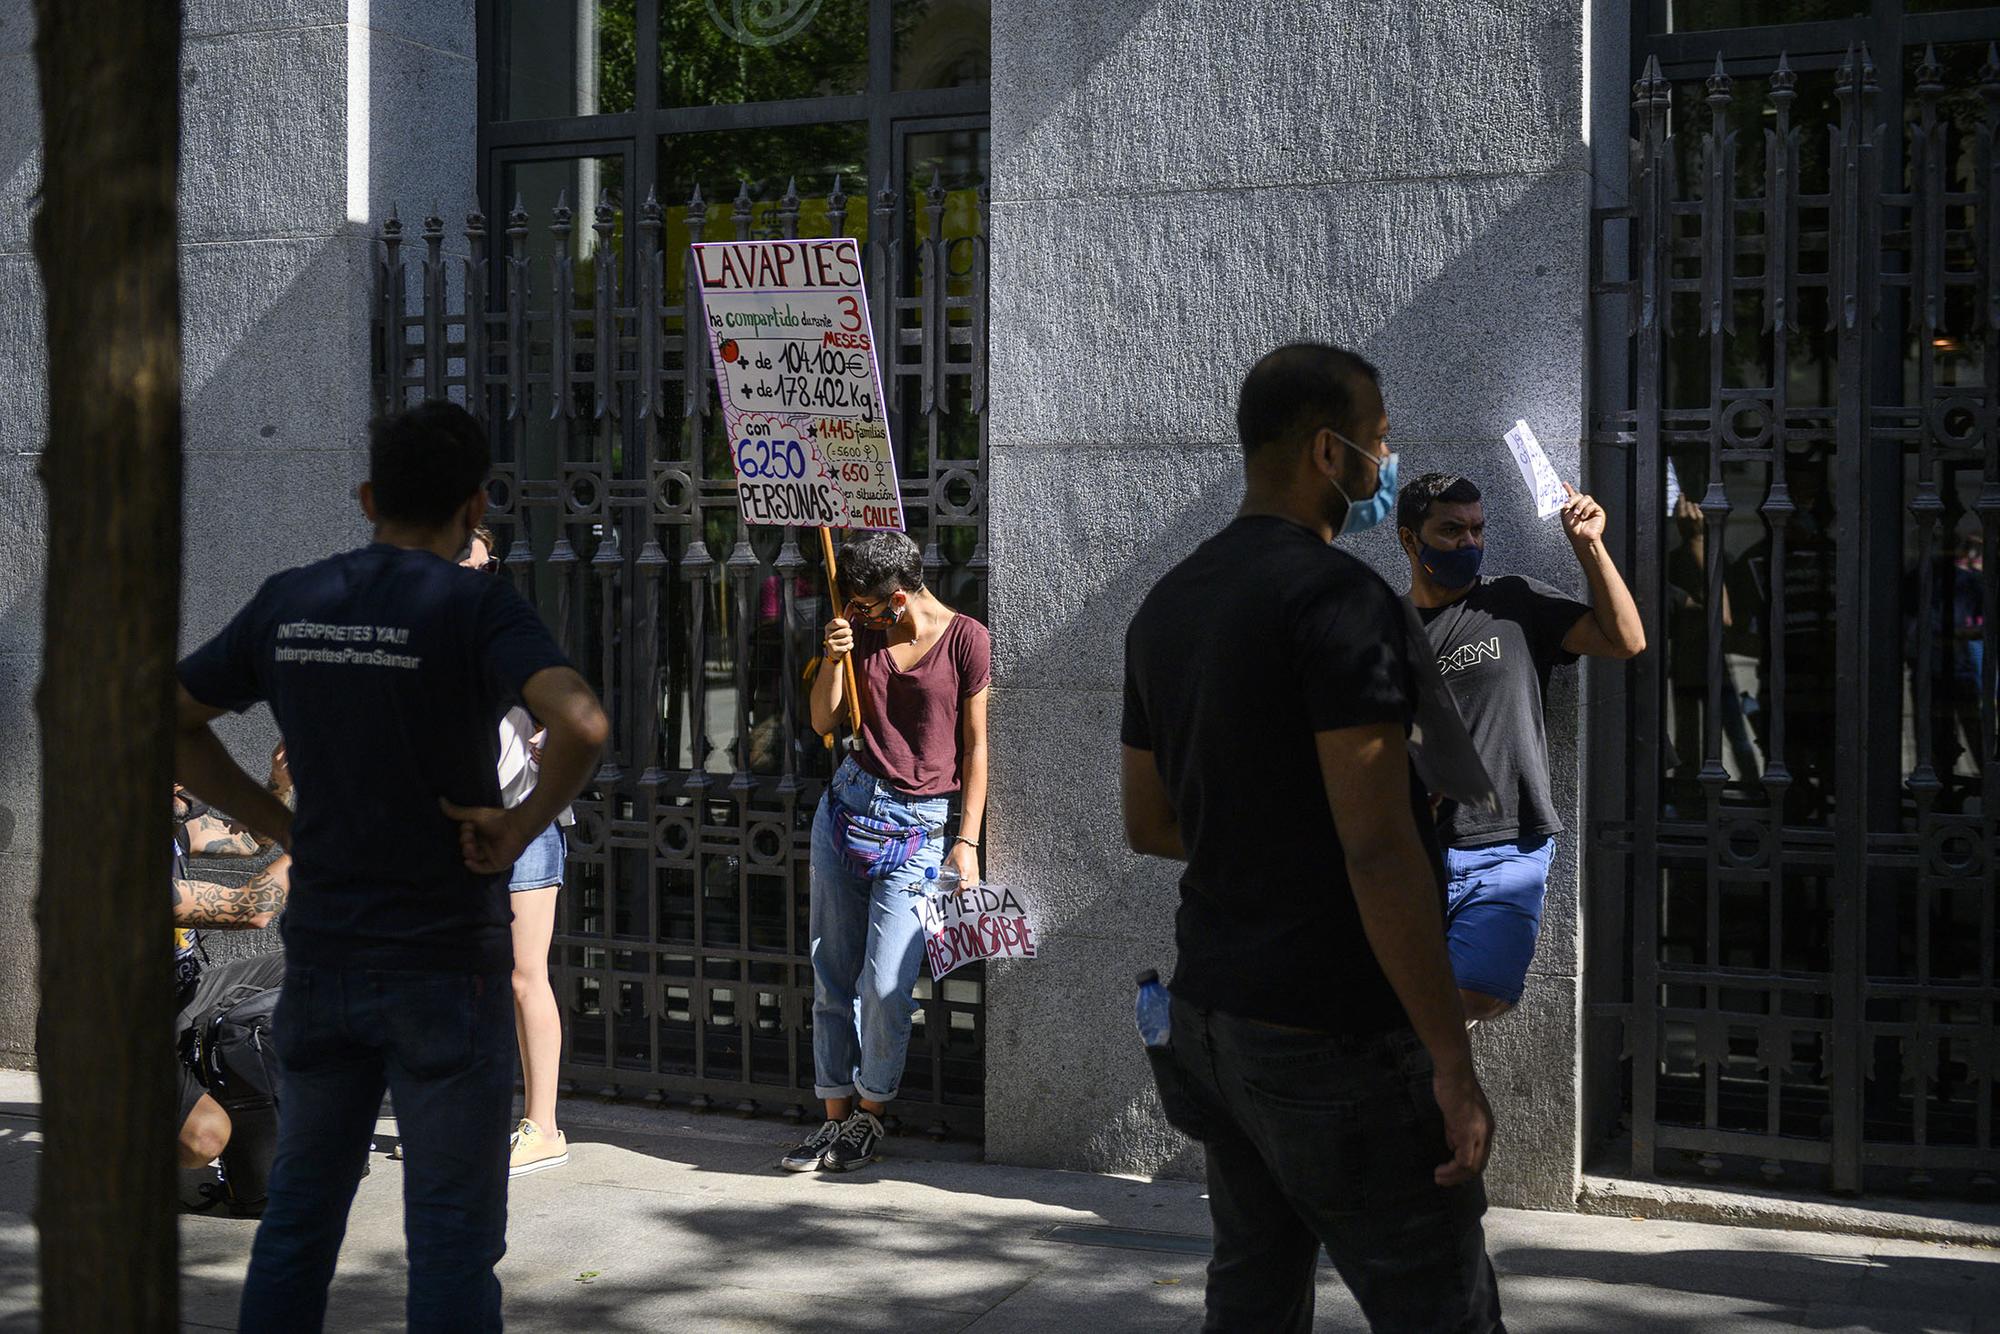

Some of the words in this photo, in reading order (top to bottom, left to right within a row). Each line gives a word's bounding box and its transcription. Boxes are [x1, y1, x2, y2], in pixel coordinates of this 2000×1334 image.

[694, 241, 861, 289] LAVAPIÉS
[707, 304, 724, 327] ha
[726, 303, 799, 337] compartido
[801, 311, 832, 328] durante
[837, 296, 862, 332] 3
[823, 331, 871, 350] MESES
[755, 352, 772, 369] de
[757, 380, 774, 397] de
[774, 375, 848, 408] 178.402
[746, 423, 771, 436] con
[854, 423, 886, 444] familias
[737, 438, 806, 479] 6250
[842, 463, 869, 482] 650
[739, 483, 840, 523] PERSONAS:
[857, 487, 897, 501] situación
[851, 505, 863, 518] de
[863, 505, 900, 528] CALLE
[277, 619, 373, 641] INTÉRPRETES
[926, 912, 1036, 977] RESPONSABLE
